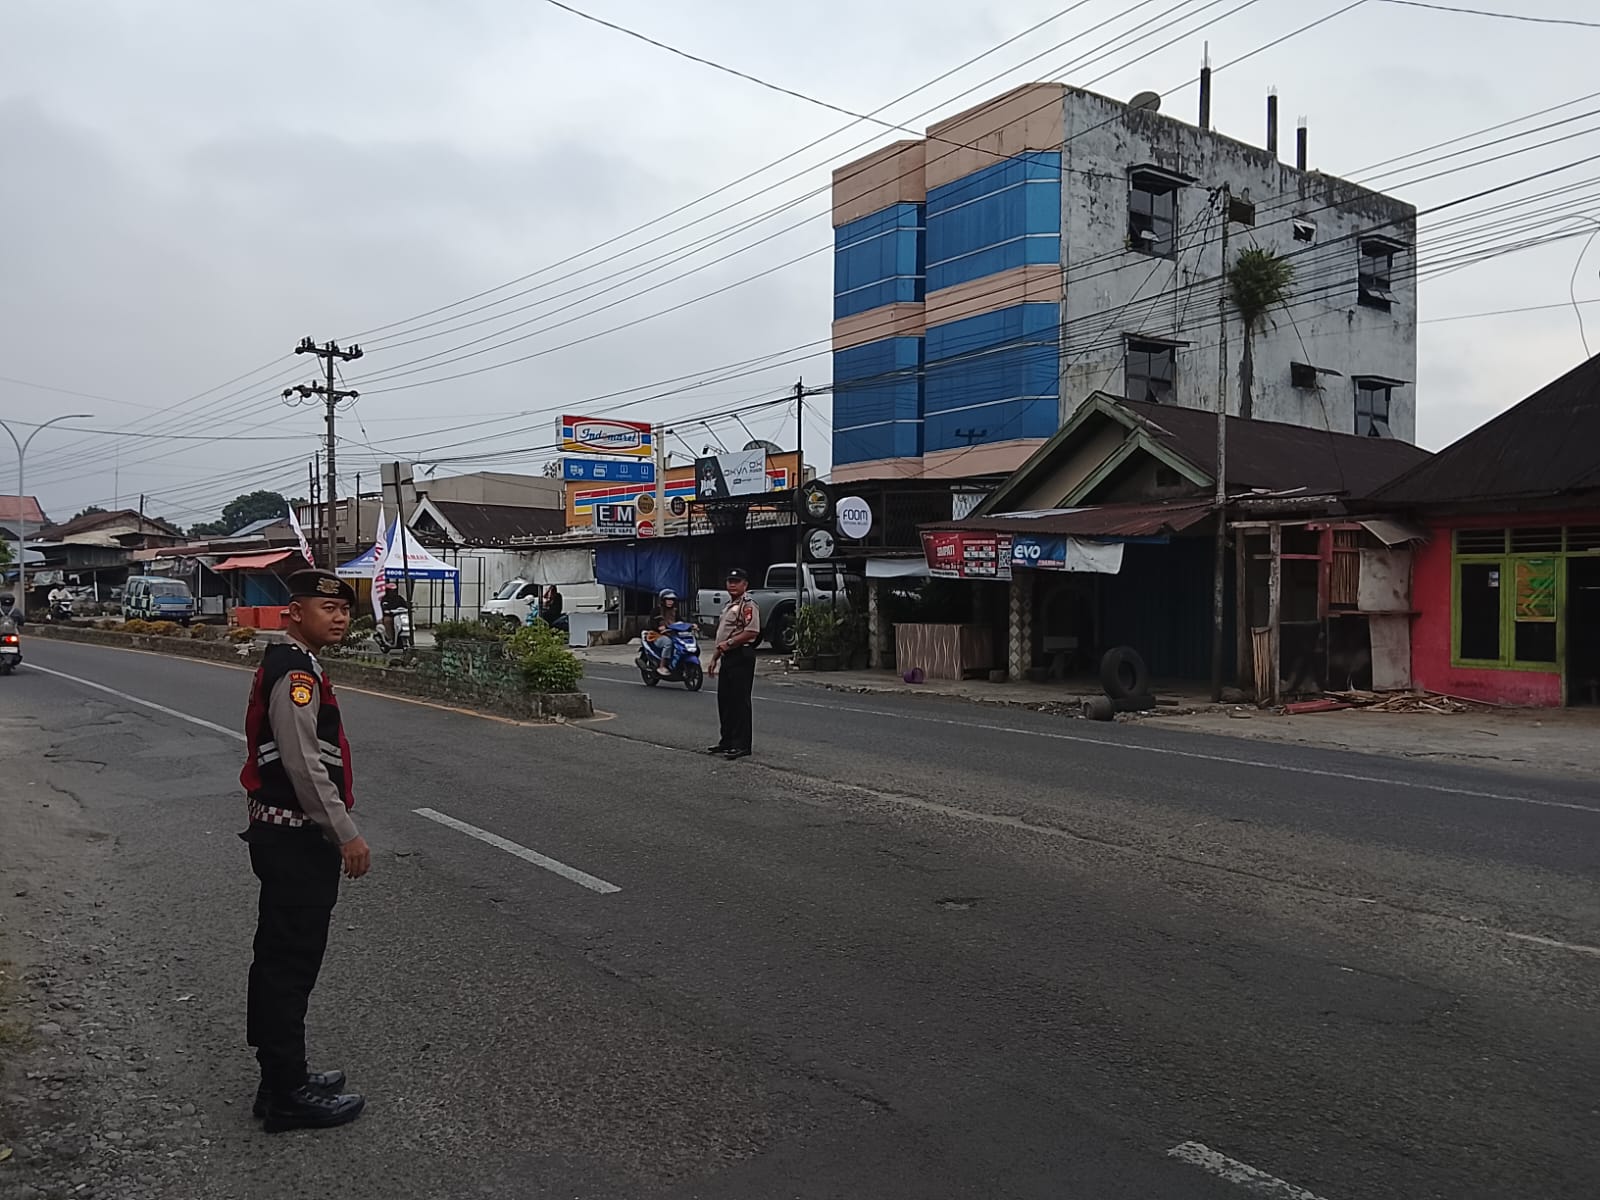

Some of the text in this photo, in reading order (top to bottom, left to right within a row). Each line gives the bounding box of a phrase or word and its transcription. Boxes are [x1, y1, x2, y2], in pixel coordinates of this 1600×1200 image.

[599, 505, 633, 522] EJM
[843, 508, 868, 520] FOOM
[403, 553, 429, 561] AMAHA
[1014, 544, 1041, 559] evo
